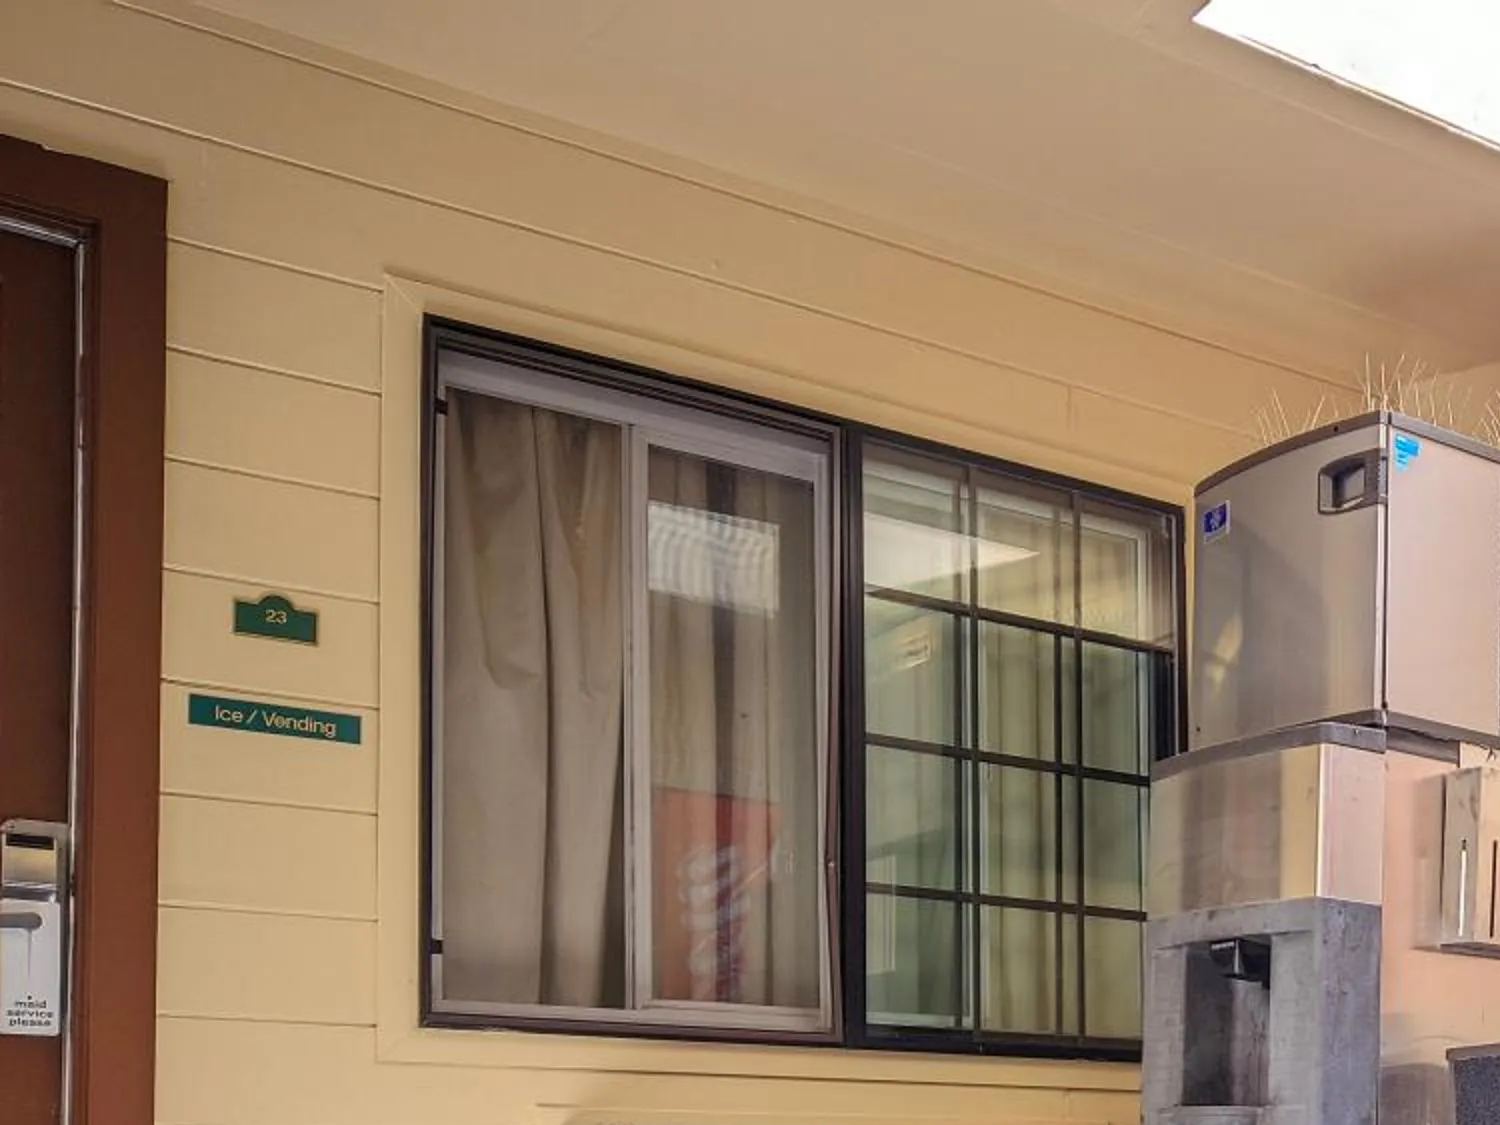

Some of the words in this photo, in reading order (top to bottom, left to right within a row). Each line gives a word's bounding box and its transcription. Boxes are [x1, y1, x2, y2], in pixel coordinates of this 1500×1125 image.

[264, 609, 288, 624] 23
[214, 704, 244, 721] Ice
[262, 710, 337, 738] Vending
[7, 1009, 53, 1018] service
[9, 1018, 51, 1027] please
